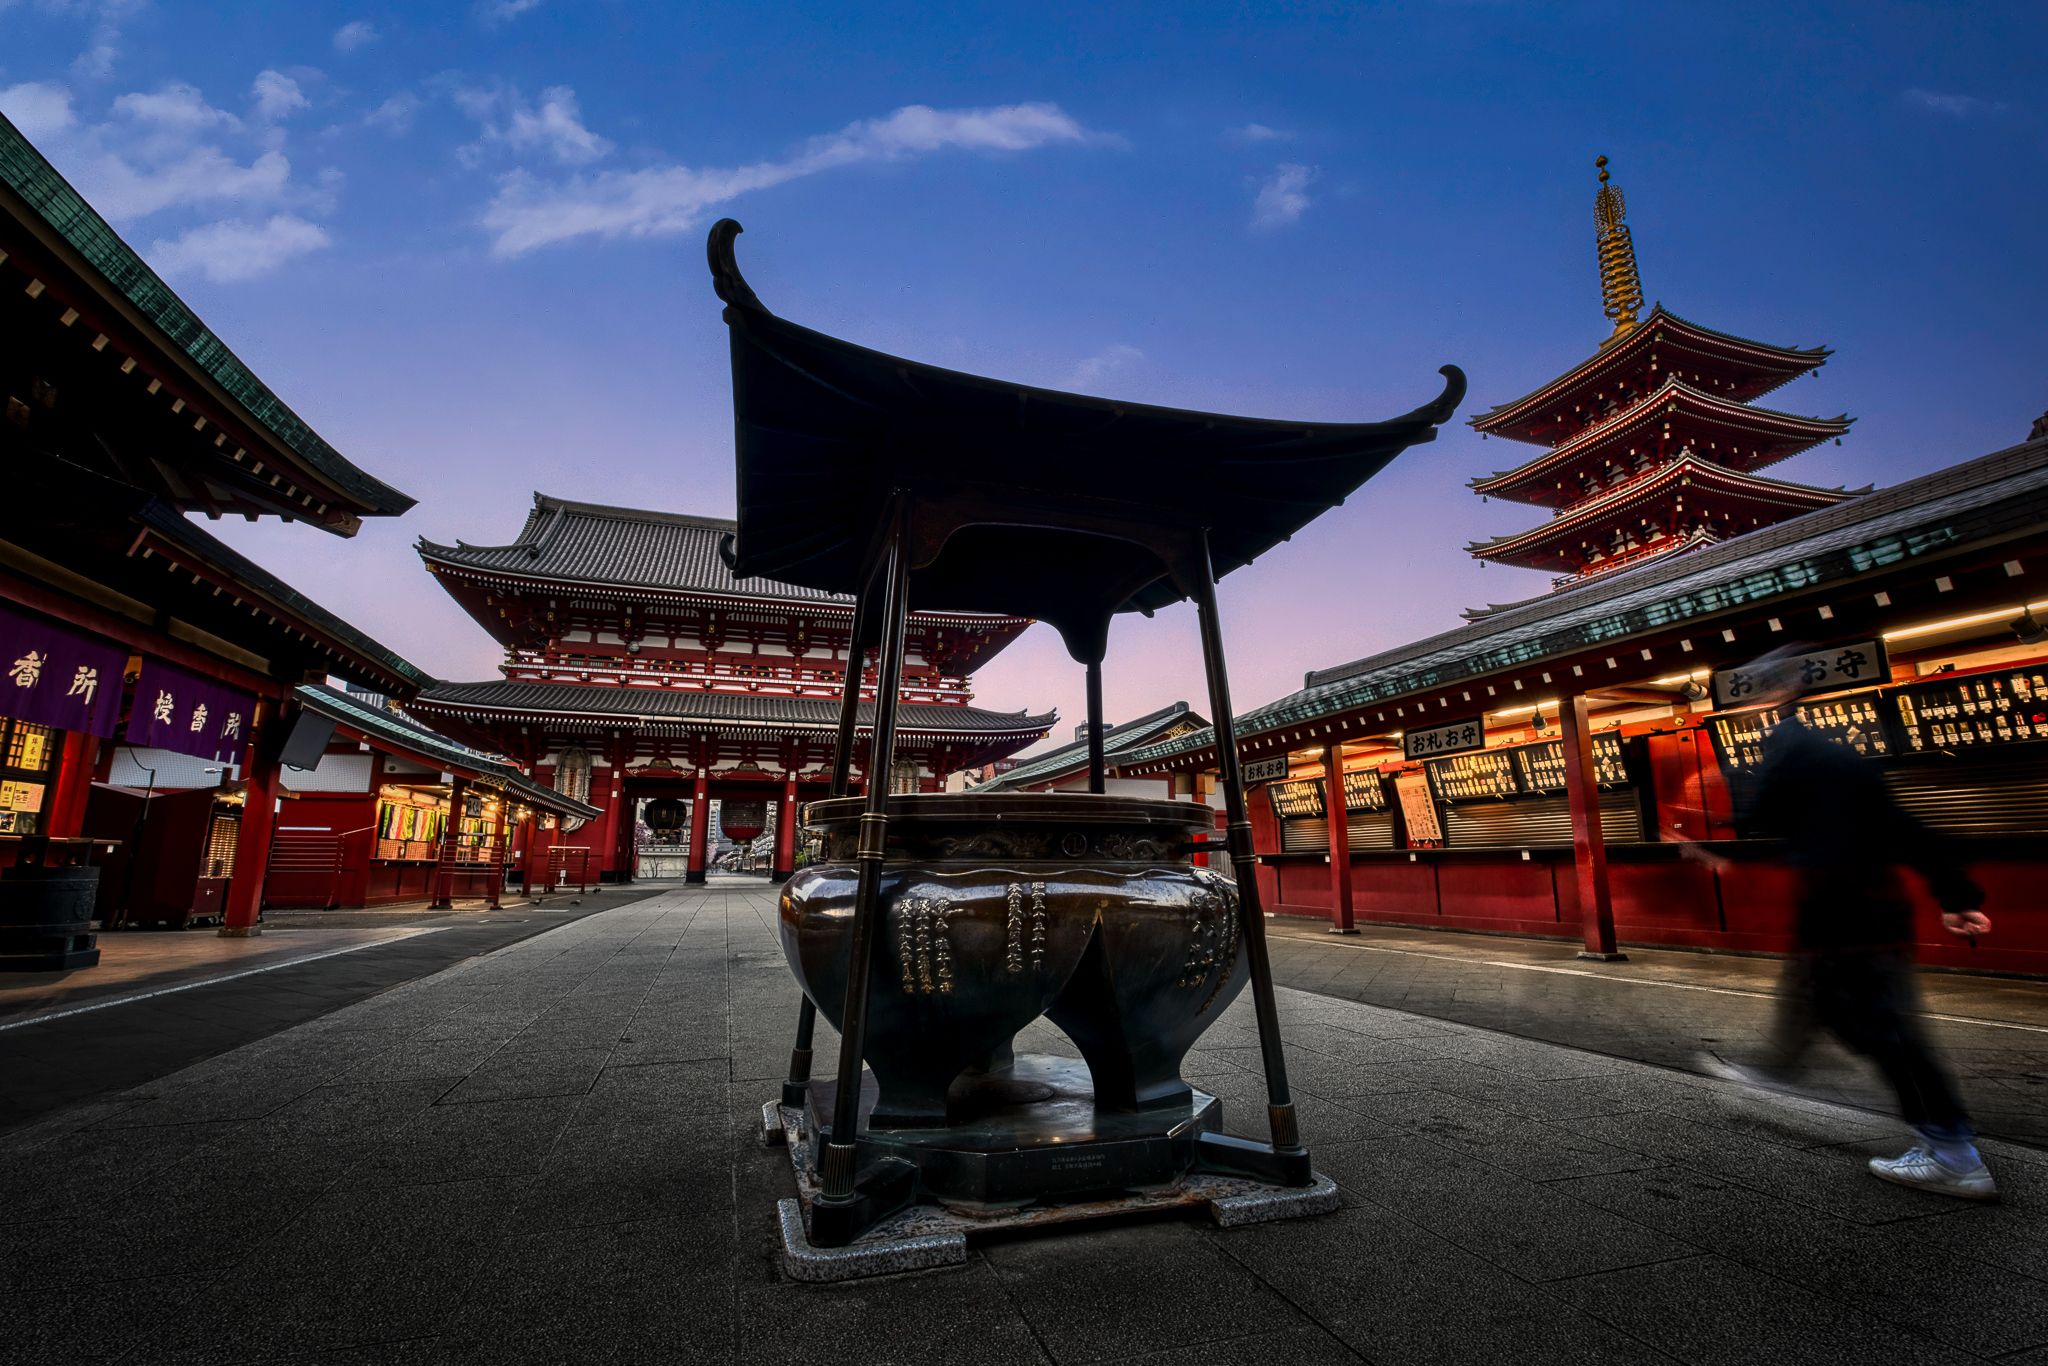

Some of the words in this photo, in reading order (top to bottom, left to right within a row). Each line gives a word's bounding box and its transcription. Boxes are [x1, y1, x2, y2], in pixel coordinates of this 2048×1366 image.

[9, 650, 97, 704] 香所
[1728, 650, 1867, 697] おお守
[154, 690, 242, 740] 授香所
[1412, 725, 1477, 753] お札お守
[1248, 760, 1284, 780] お札お守
